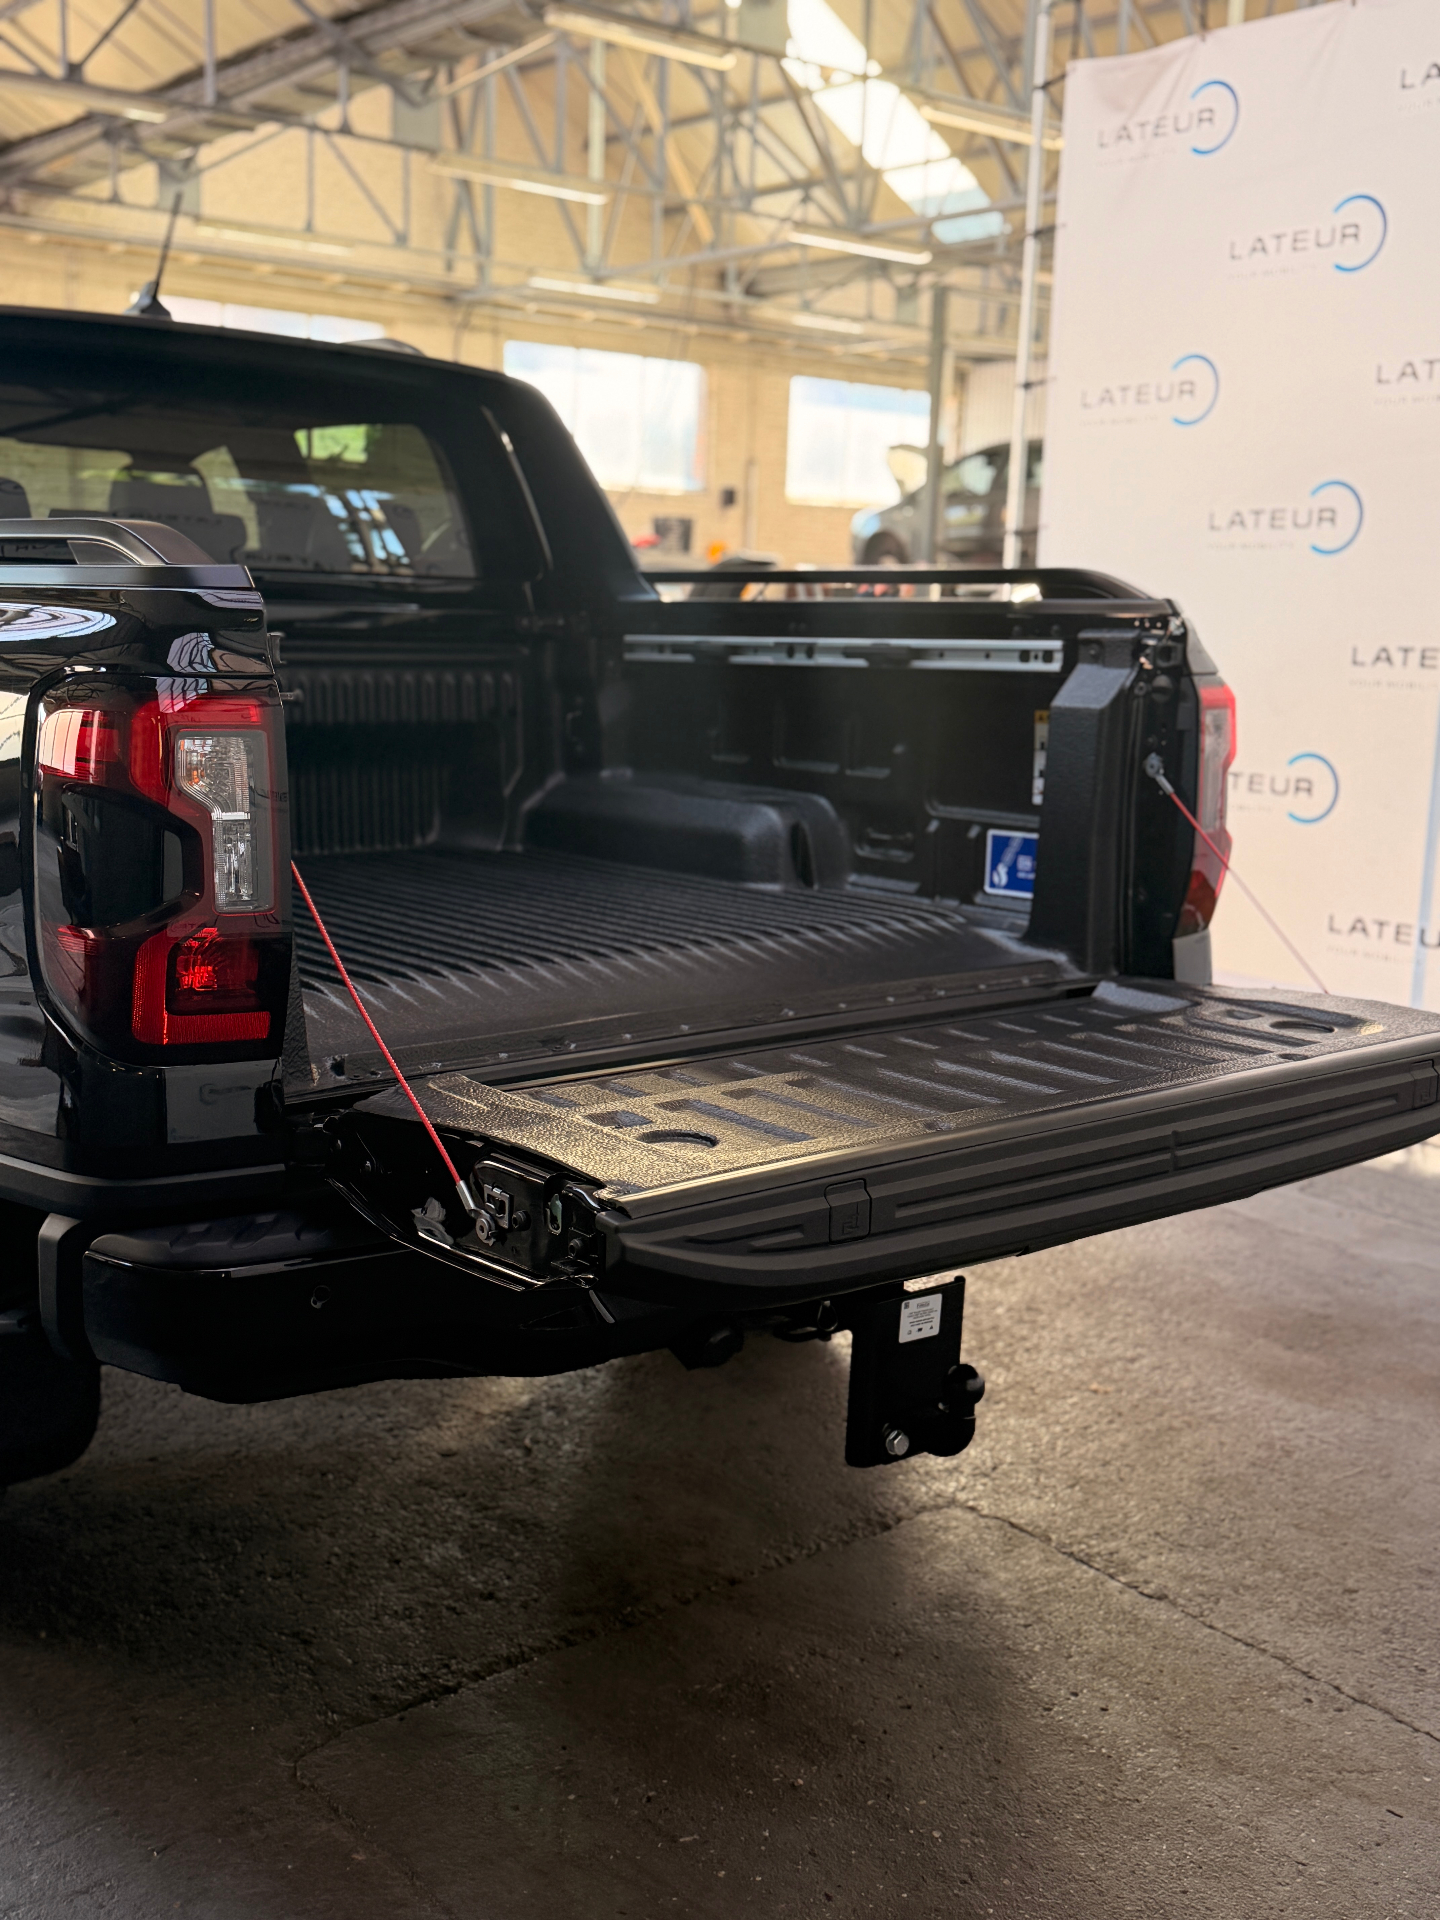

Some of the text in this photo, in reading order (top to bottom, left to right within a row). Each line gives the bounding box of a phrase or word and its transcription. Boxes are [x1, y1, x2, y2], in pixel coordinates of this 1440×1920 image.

[1098, 106, 1216, 149] LATEUR
[1228, 222, 1361, 261] LATEUR
[1080, 379, 1197, 410] LATEUR
[1208, 507, 1337, 532] LATEUR
[1351, 645, 1440, 669] LATE
